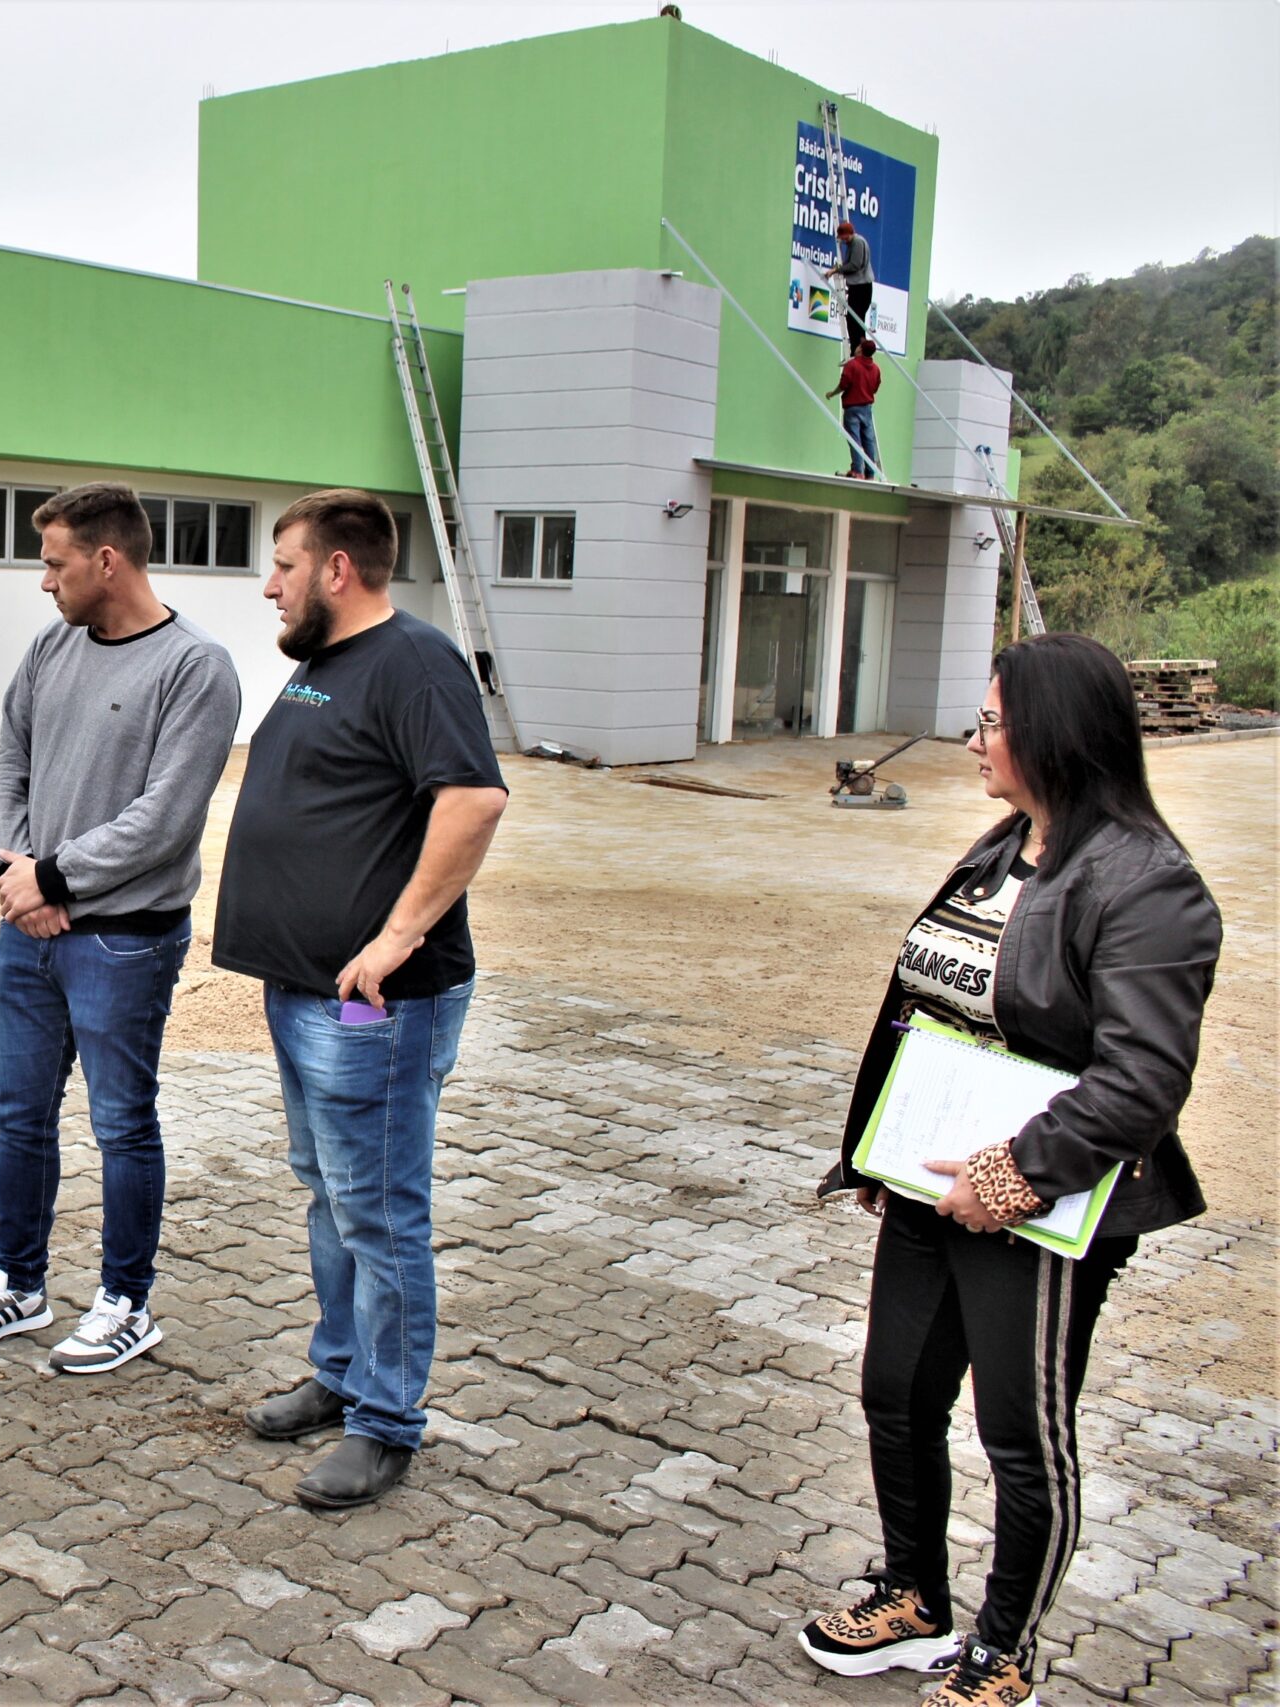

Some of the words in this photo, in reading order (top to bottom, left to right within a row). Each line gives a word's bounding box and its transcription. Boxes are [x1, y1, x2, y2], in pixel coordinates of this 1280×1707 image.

[799, 137, 826, 160] Básica
[860, 186, 879, 218] do
[792, 241, 833, 266] Municipal
